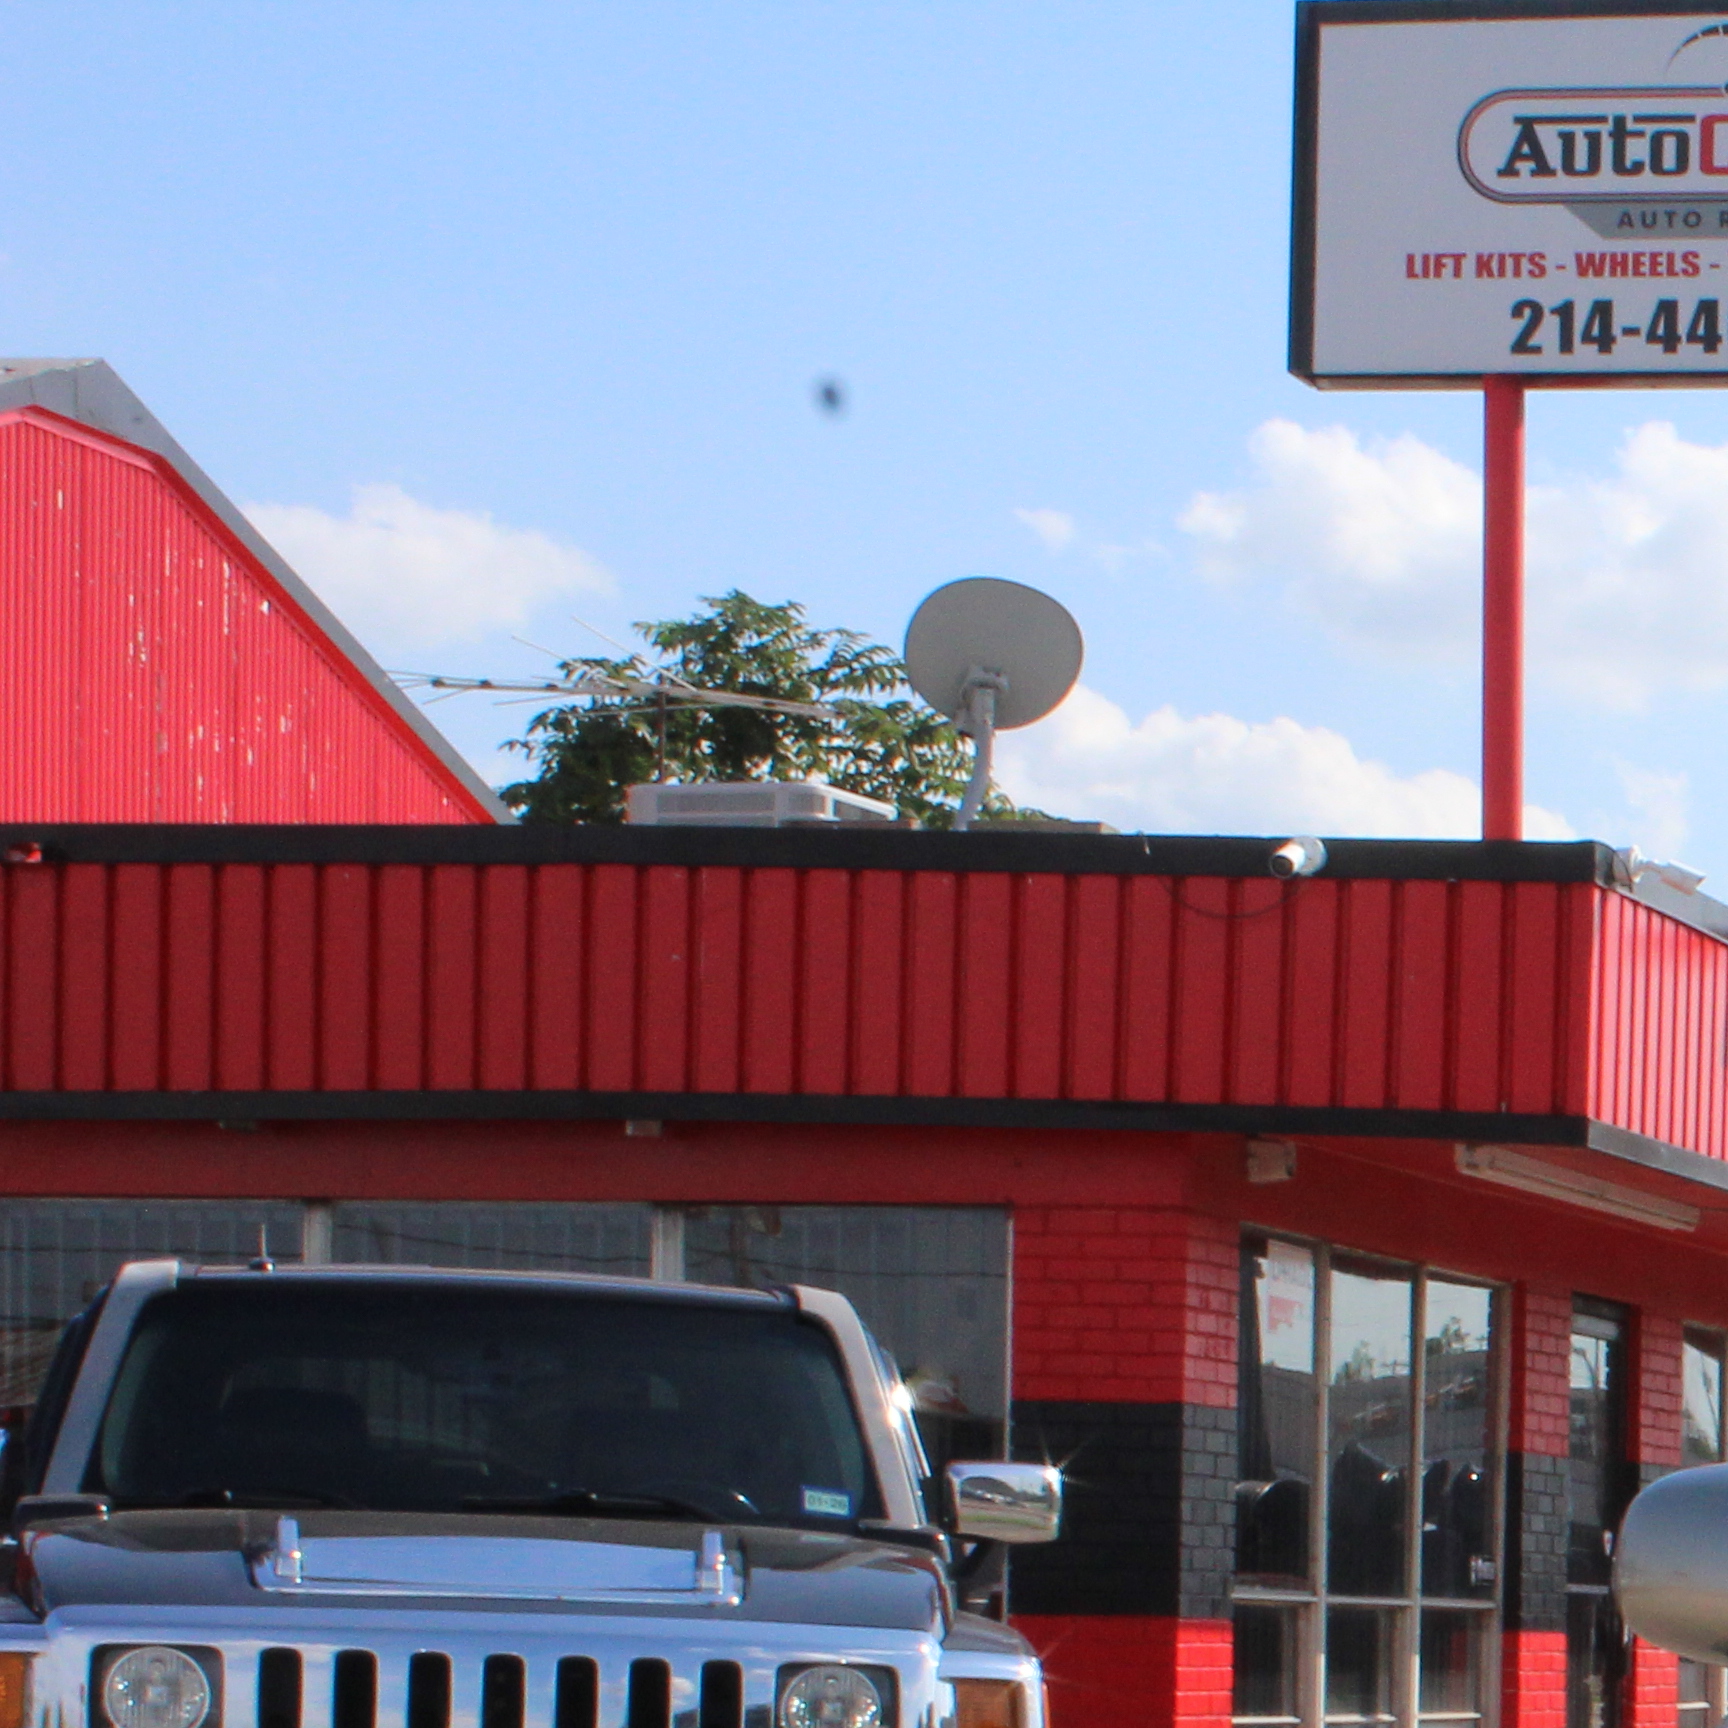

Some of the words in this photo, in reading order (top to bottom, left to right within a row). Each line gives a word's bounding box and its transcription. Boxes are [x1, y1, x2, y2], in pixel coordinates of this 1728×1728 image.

[1616, 209, 1702, 229] AUTO
[1405, 252, 1467, 279] LIFT
[1474, 251, 1547, 279] KITS
[1574, 250, 1700, 278] WHEELS
